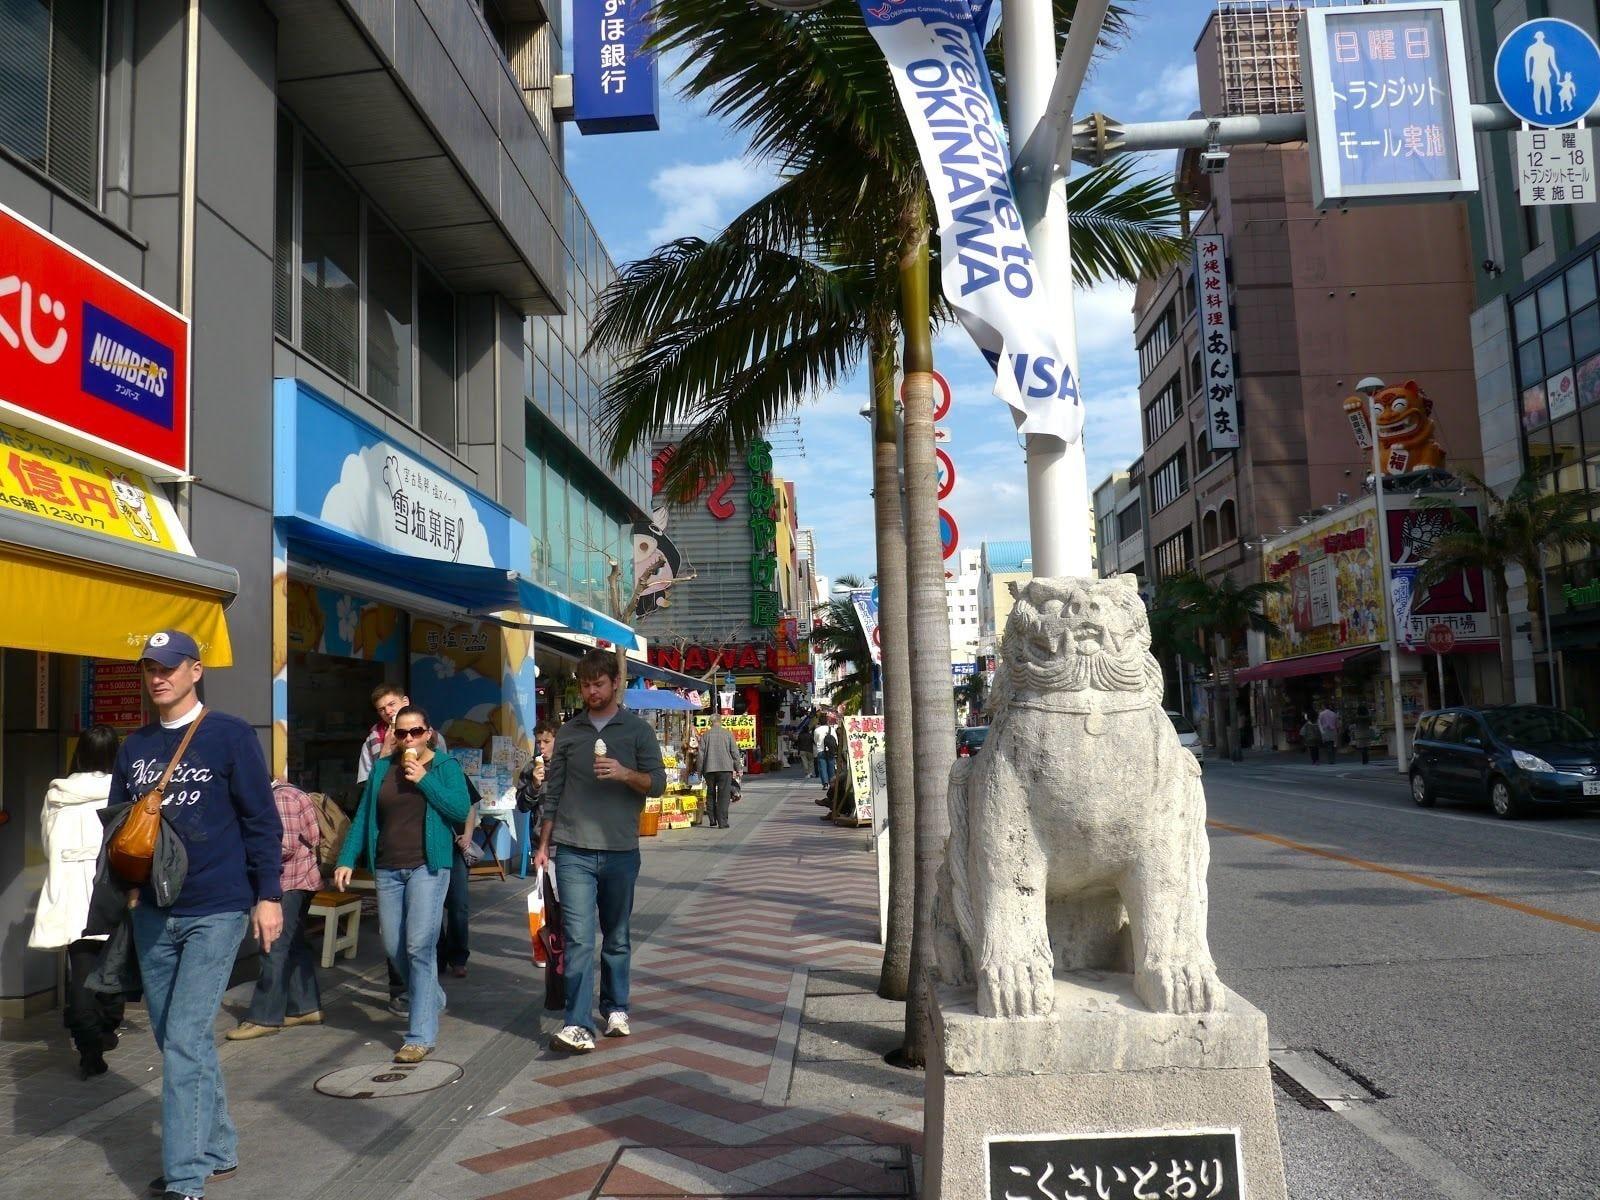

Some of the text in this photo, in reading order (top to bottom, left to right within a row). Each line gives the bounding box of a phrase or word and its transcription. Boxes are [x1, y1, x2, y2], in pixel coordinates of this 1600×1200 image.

[1335, 28, 1430, 62] 日曜日
[1331, 77, 1446, 111] トランジット
[1339, 125, 1446, 159] モール実施
[1532, 132, 1577, 150] 日曜
[905, 58, 1001, 297] OKINAWA
[934, 28, 1034, 299] Welcome to
[1523, 167, 1590, 184] トランジットモール
[1532, 184, 1584, 201] 実施日
[89, 332, 168, 398] NUMBERS
[0, 452, 119, 519] 億円
[1006, 1158, 1224, 1200] こくさいとおり
